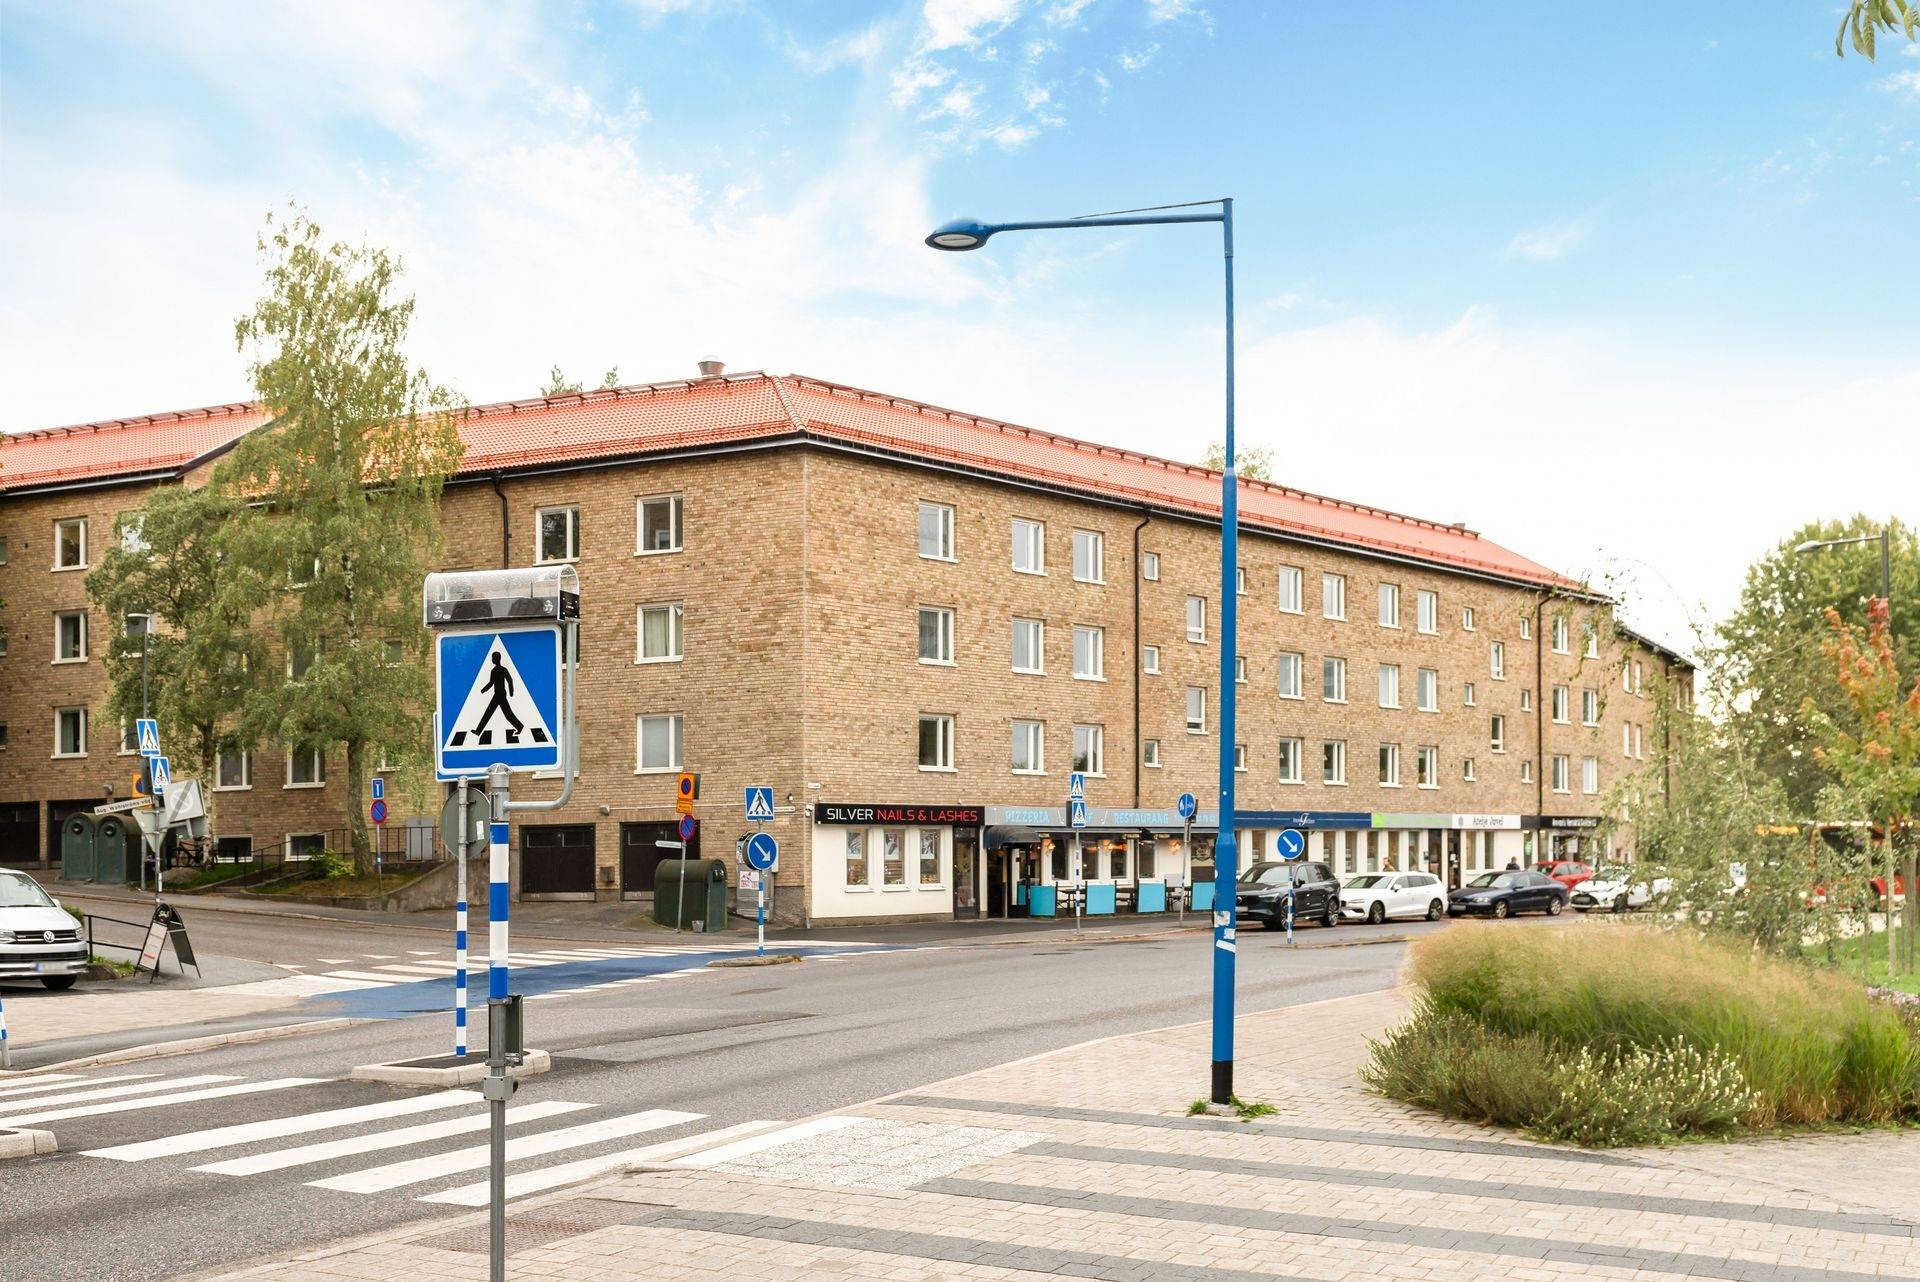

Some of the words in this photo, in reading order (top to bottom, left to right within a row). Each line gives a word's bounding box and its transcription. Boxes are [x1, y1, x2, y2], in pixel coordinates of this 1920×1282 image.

[827, 808, 873, 820] SILVER
[877, 809, 915, 820] NAILS
[918, 810, 926, 821] &
[931, 810, 977, 822] LASHES
[1004, 809, 1050, 823] PIZZERIA
[1114, 812, 1169, 825] RESTAURANG
